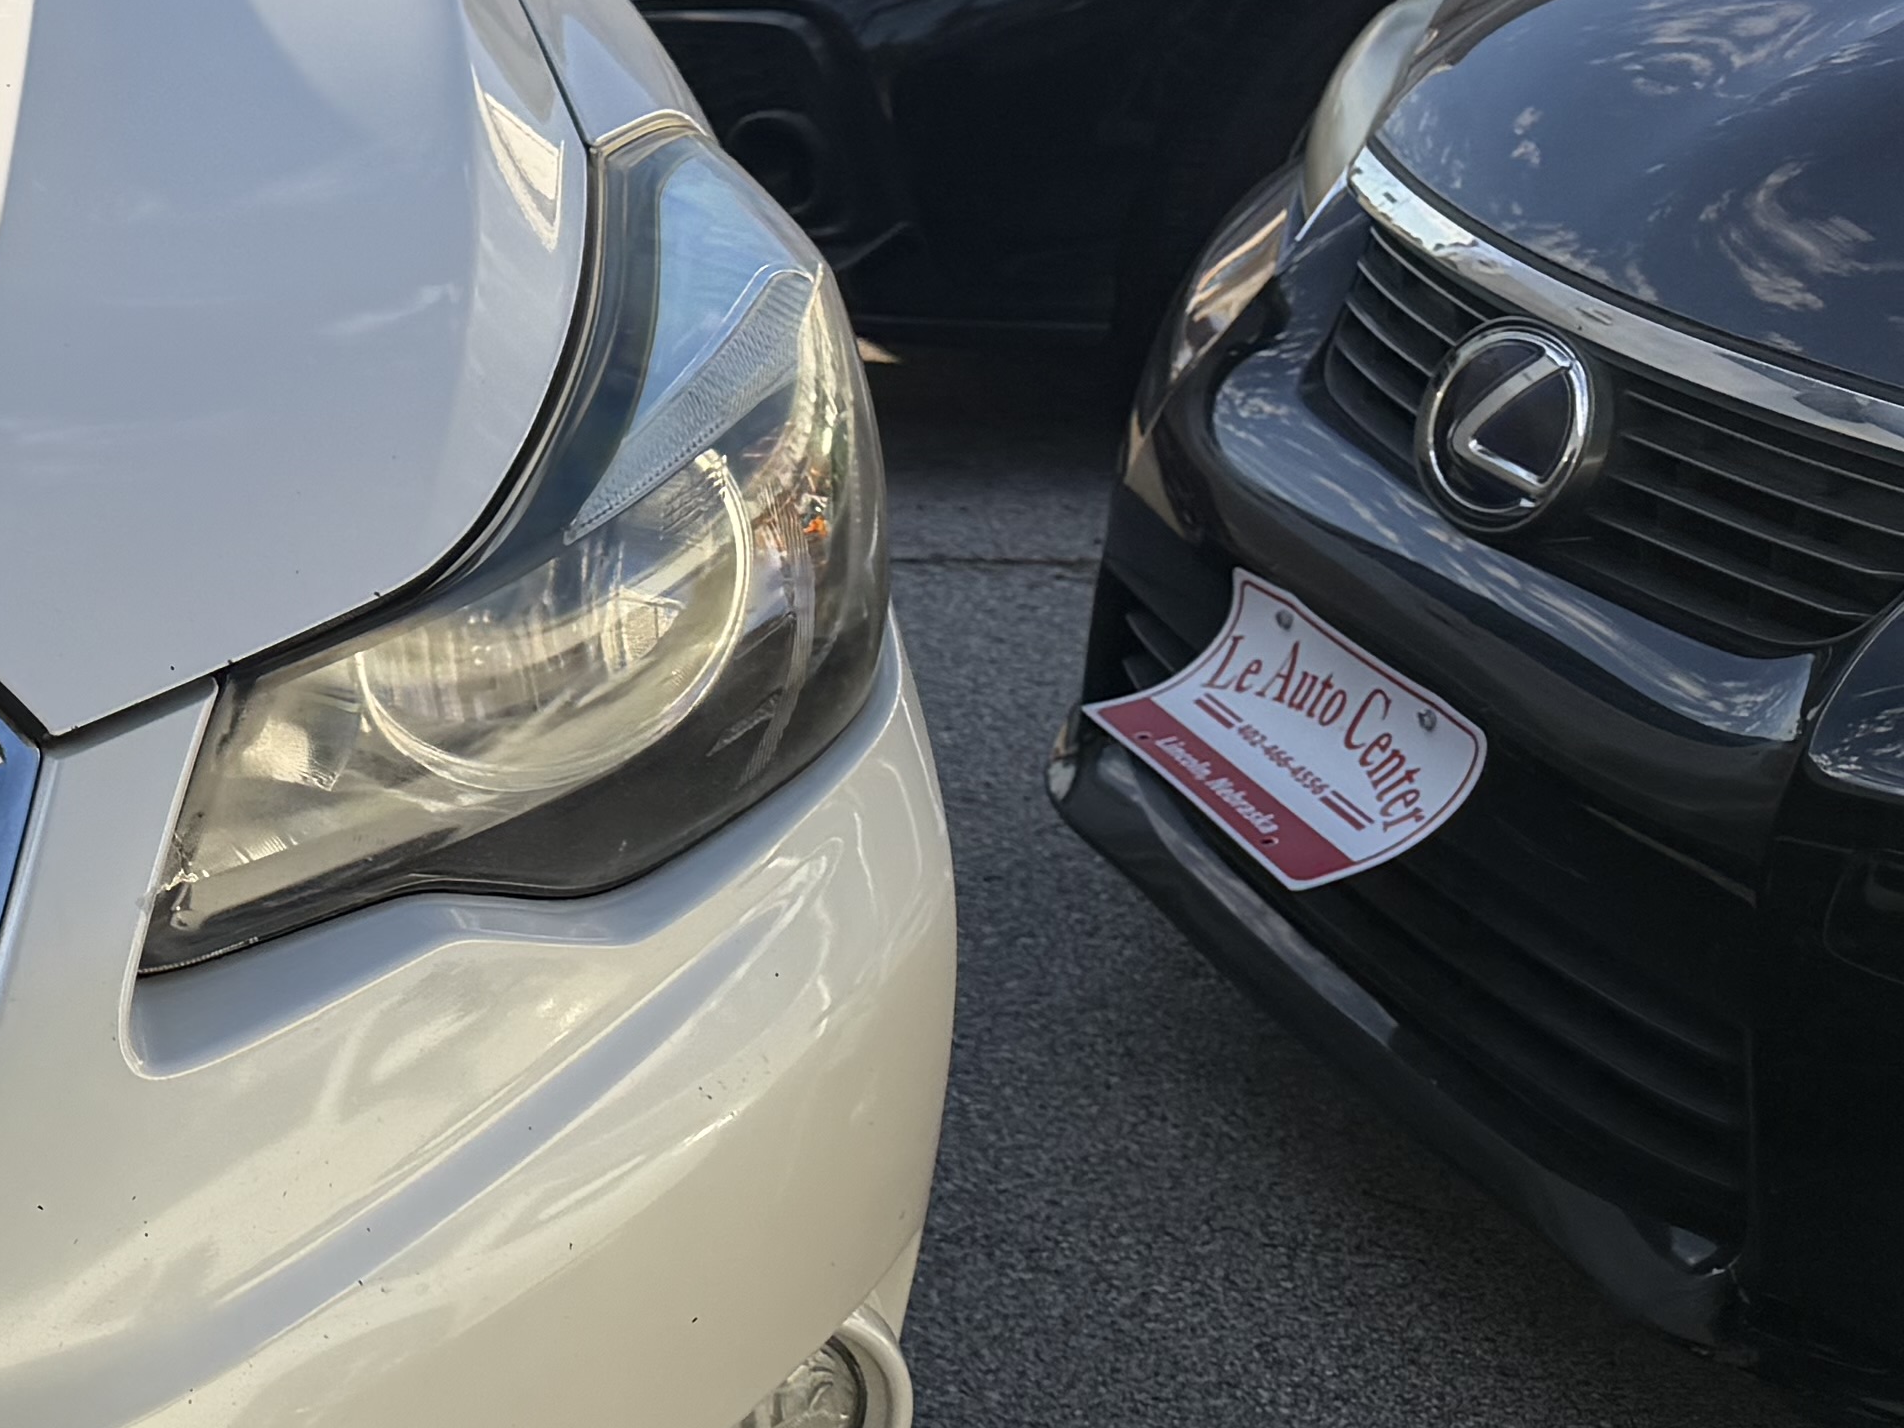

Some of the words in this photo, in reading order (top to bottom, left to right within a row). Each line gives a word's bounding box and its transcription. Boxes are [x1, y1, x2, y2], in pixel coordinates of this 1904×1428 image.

[1201, 635, 1263, 694] Le
[1253, 640, 1348, 727] Auto
[1344, 688, 1426, 834] Center
[1204, 777, 1279, 835] Nebraska
